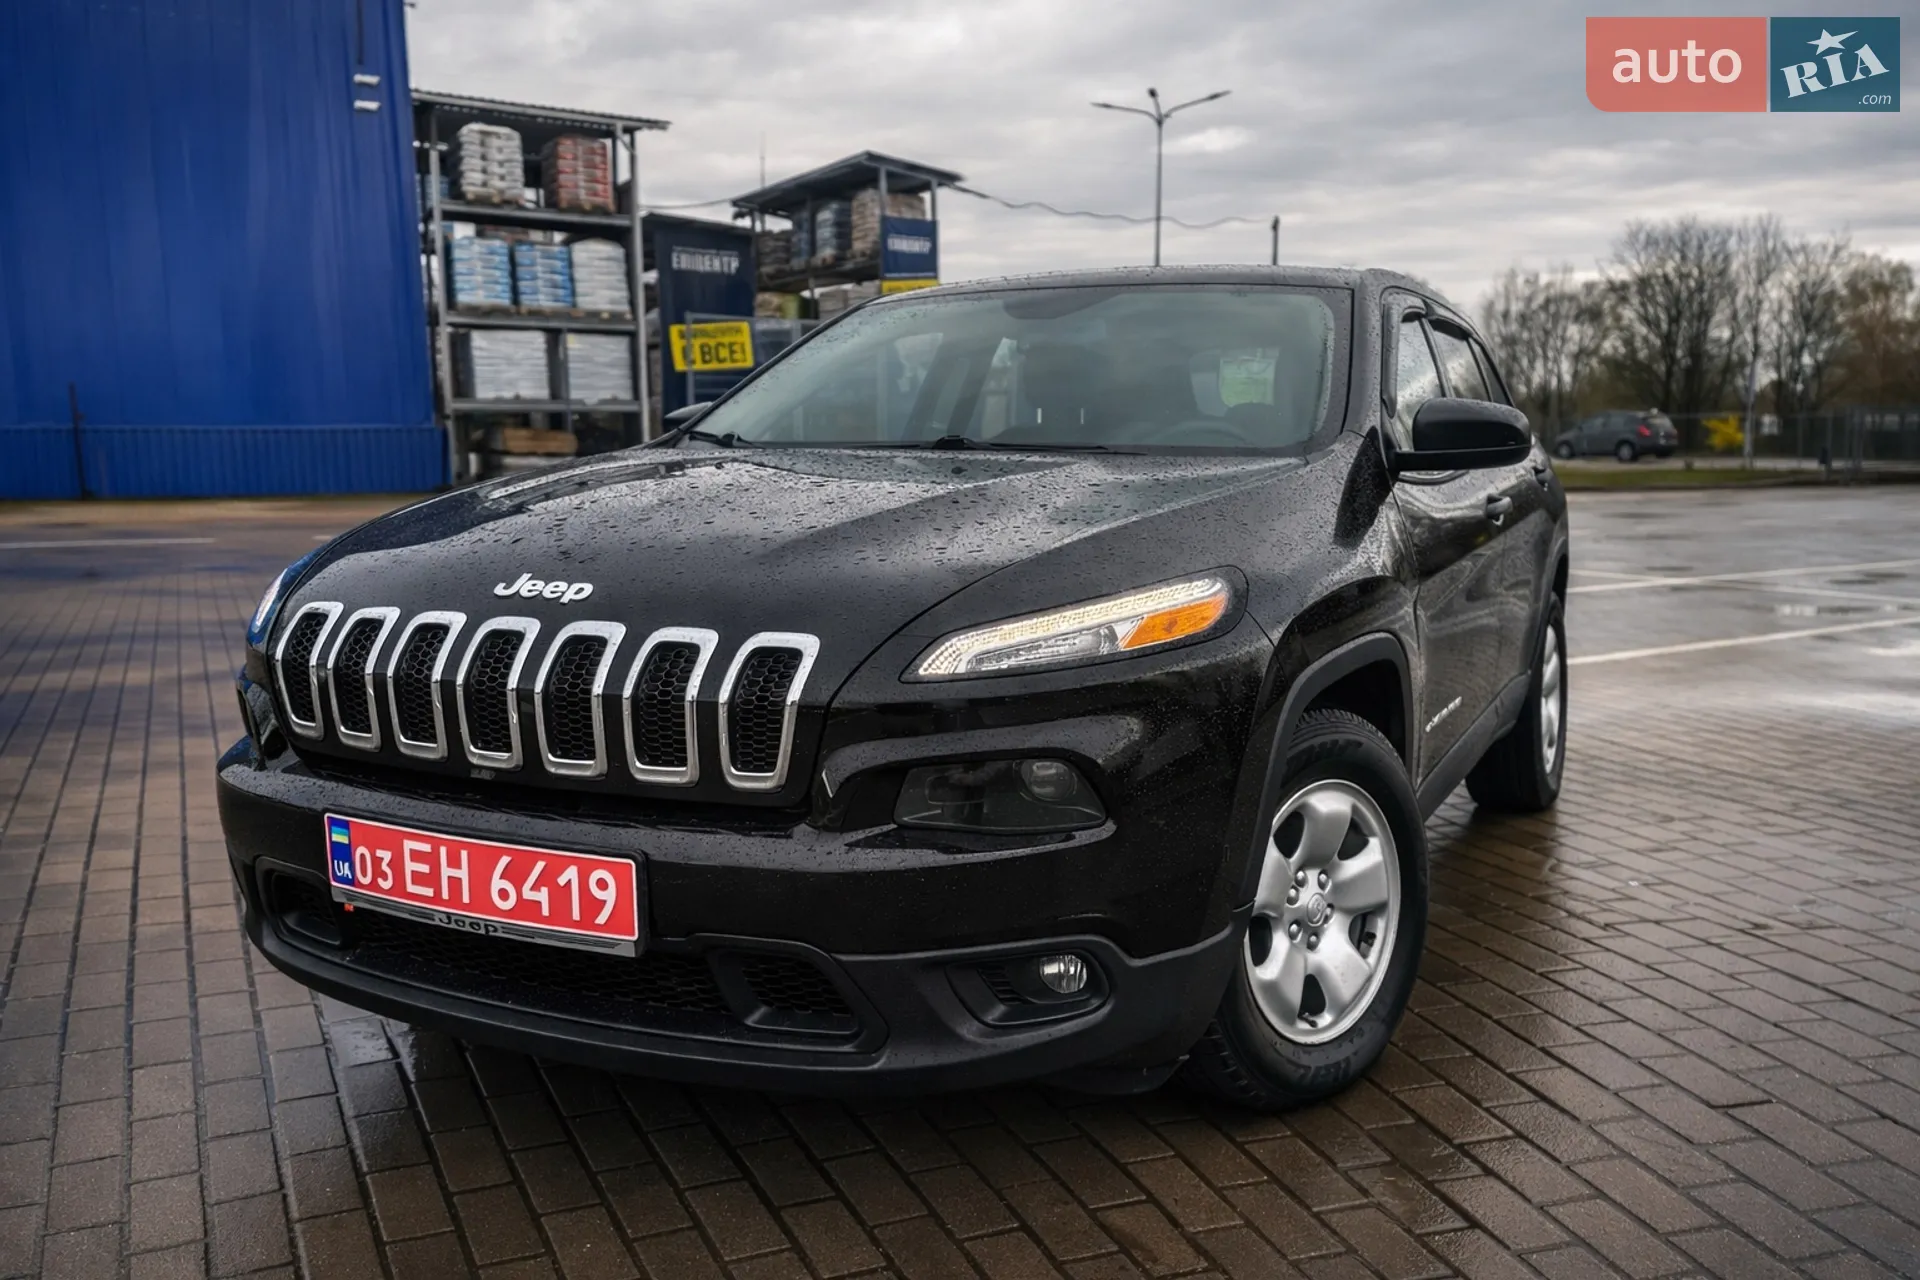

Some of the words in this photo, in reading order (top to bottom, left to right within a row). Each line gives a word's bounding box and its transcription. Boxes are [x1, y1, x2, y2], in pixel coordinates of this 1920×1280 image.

[493, 572, 594, 604] Jeep
[334, 860, 352, 880] UA
[355, 846, 394, 890] 03
[403, 839, 470, 904] EH
[490, 855, 617, 926] 6419
